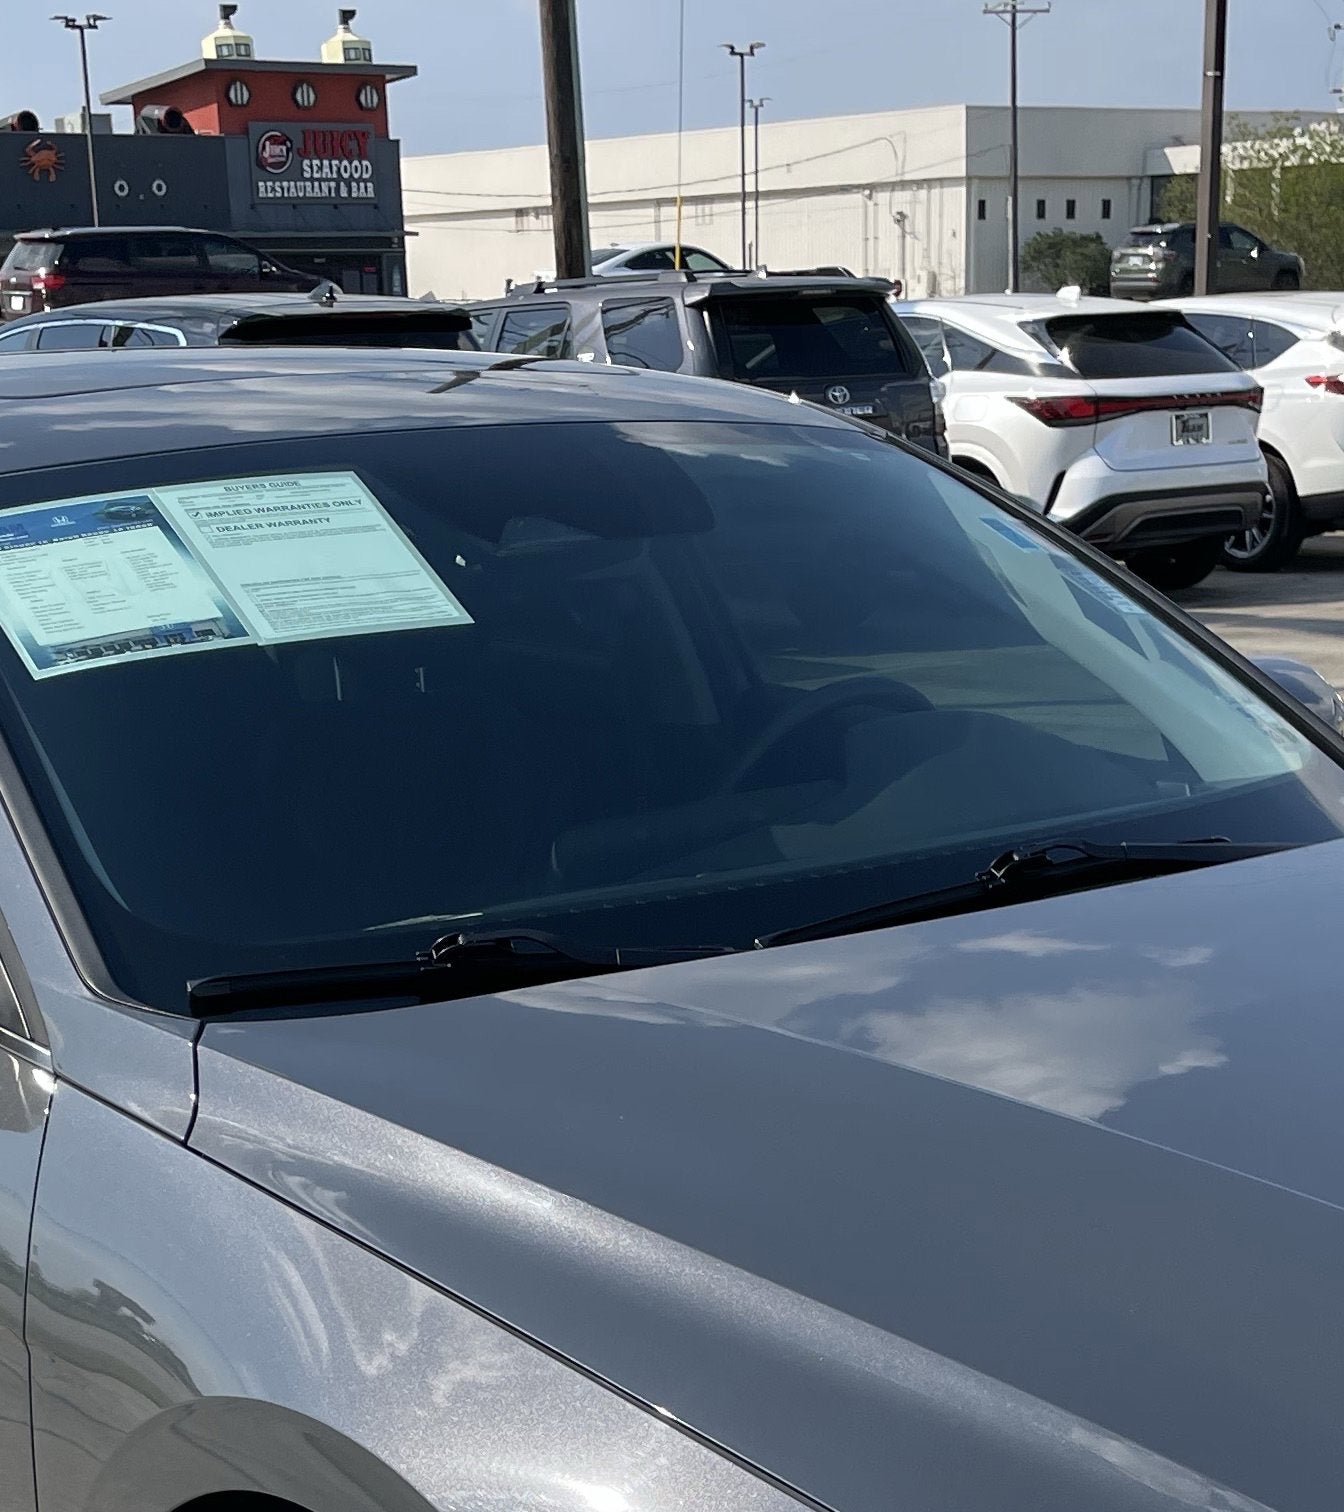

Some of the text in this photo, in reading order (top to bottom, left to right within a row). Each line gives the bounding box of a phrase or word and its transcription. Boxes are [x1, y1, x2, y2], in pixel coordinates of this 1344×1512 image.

[297, 129, 369, 159] JUICY
[302, 159, 373, 179] SEAFOOD
[258, 181, 375, 198] RESTAURANT & BAR
[224, 480, 301, 492] BUYERS GUIDE
[205, 507, 253, 519] IMPLIED
[255, 501, 331, 514] WARRANTIES
[332, 499, 362, 509] ONLY
[216, 516, 331, 533] DEALER WARRANTY
